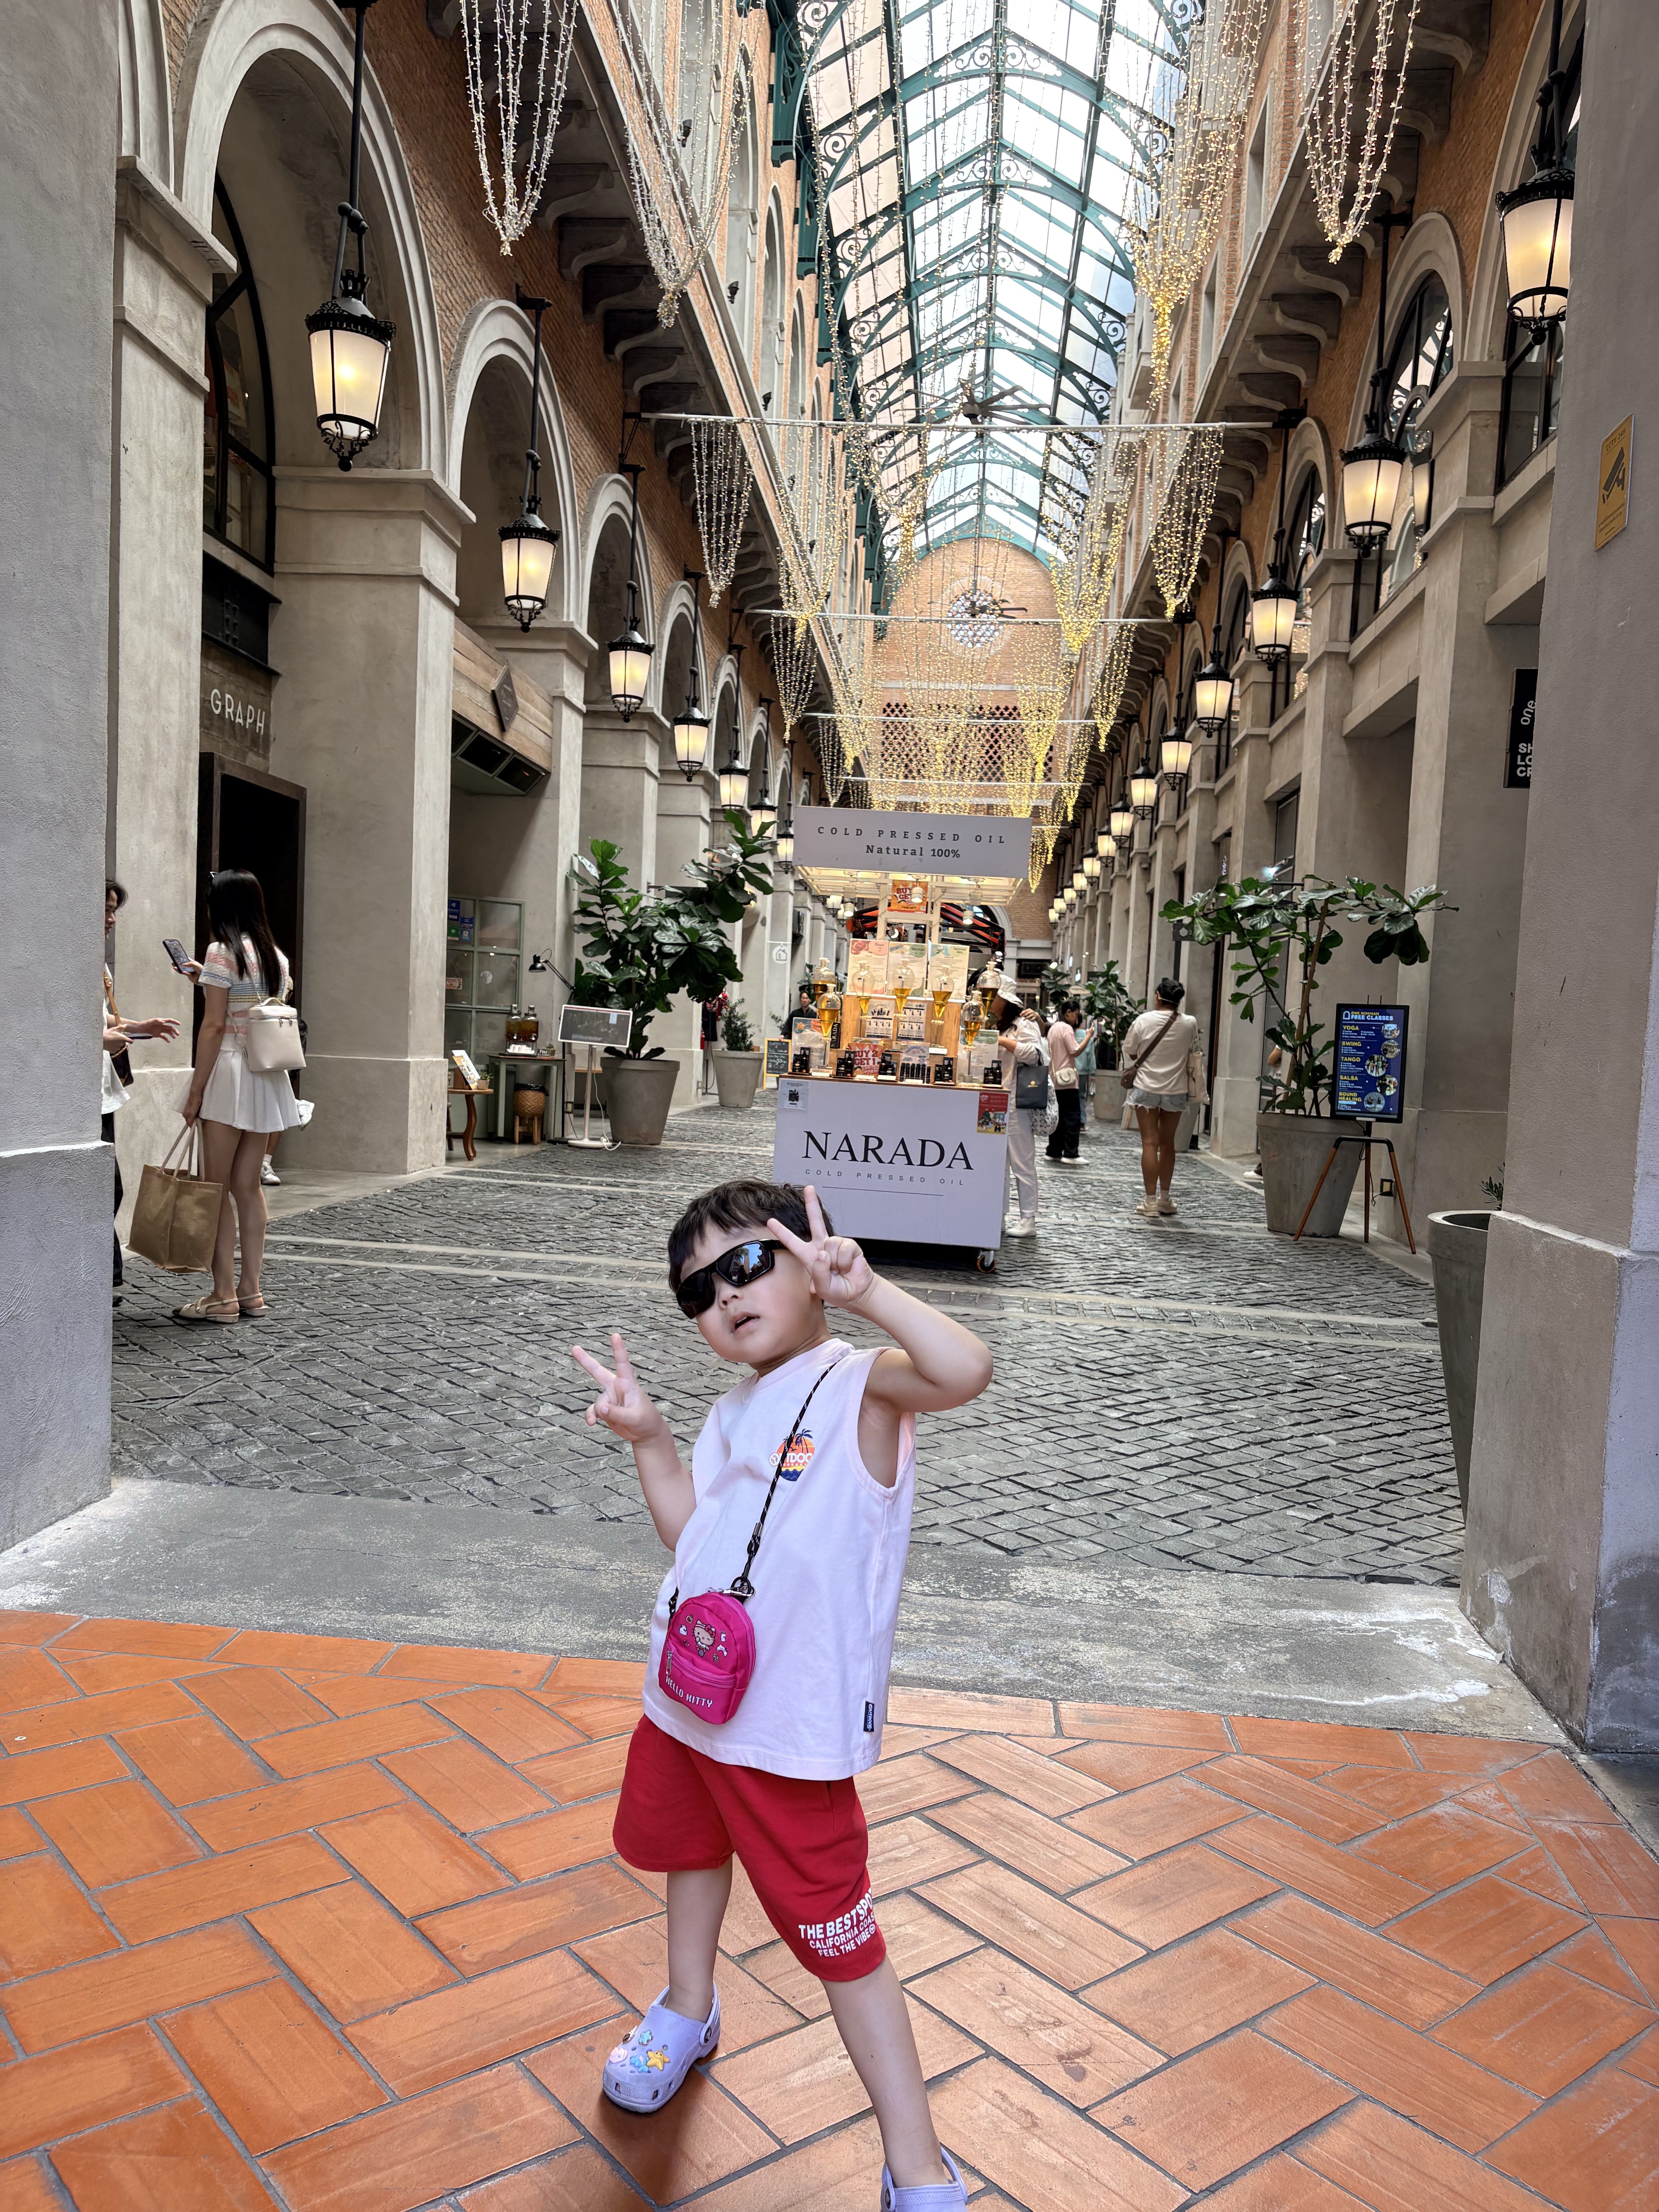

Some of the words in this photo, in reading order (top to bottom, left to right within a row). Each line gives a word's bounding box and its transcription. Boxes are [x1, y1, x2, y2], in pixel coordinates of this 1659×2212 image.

[210, 689, 265, 735] GRAPH
[1521, 700, 1536, 725] one
[817, 826, 863, 836] COLD
[878, 830, 960, 842] PRESSED
[975, 834, 1005, 843] OIL
[866, 845, 924, 857] Natural
[931, 848, 960, 859] 100%
[802, 1130, 974, 1170] NARADA
[857, 1173, 925, 1182] PRESSED
[666, 1675, 684, 1698] HELLO
[686, 1693, 713, 1708] KITTY
[798, 1923, 824, 1939] THE
[826, 1908, 857, 1937] BEST
[856, 1887, 872, 1921] SPO
[809, 1926, 859, 1949] CALIFORNIA
[817, 1948, 840, 1958] FEEL
[840, 1942, 856, 1954] THE
[855, 1929, 871, 1946] VIBE
